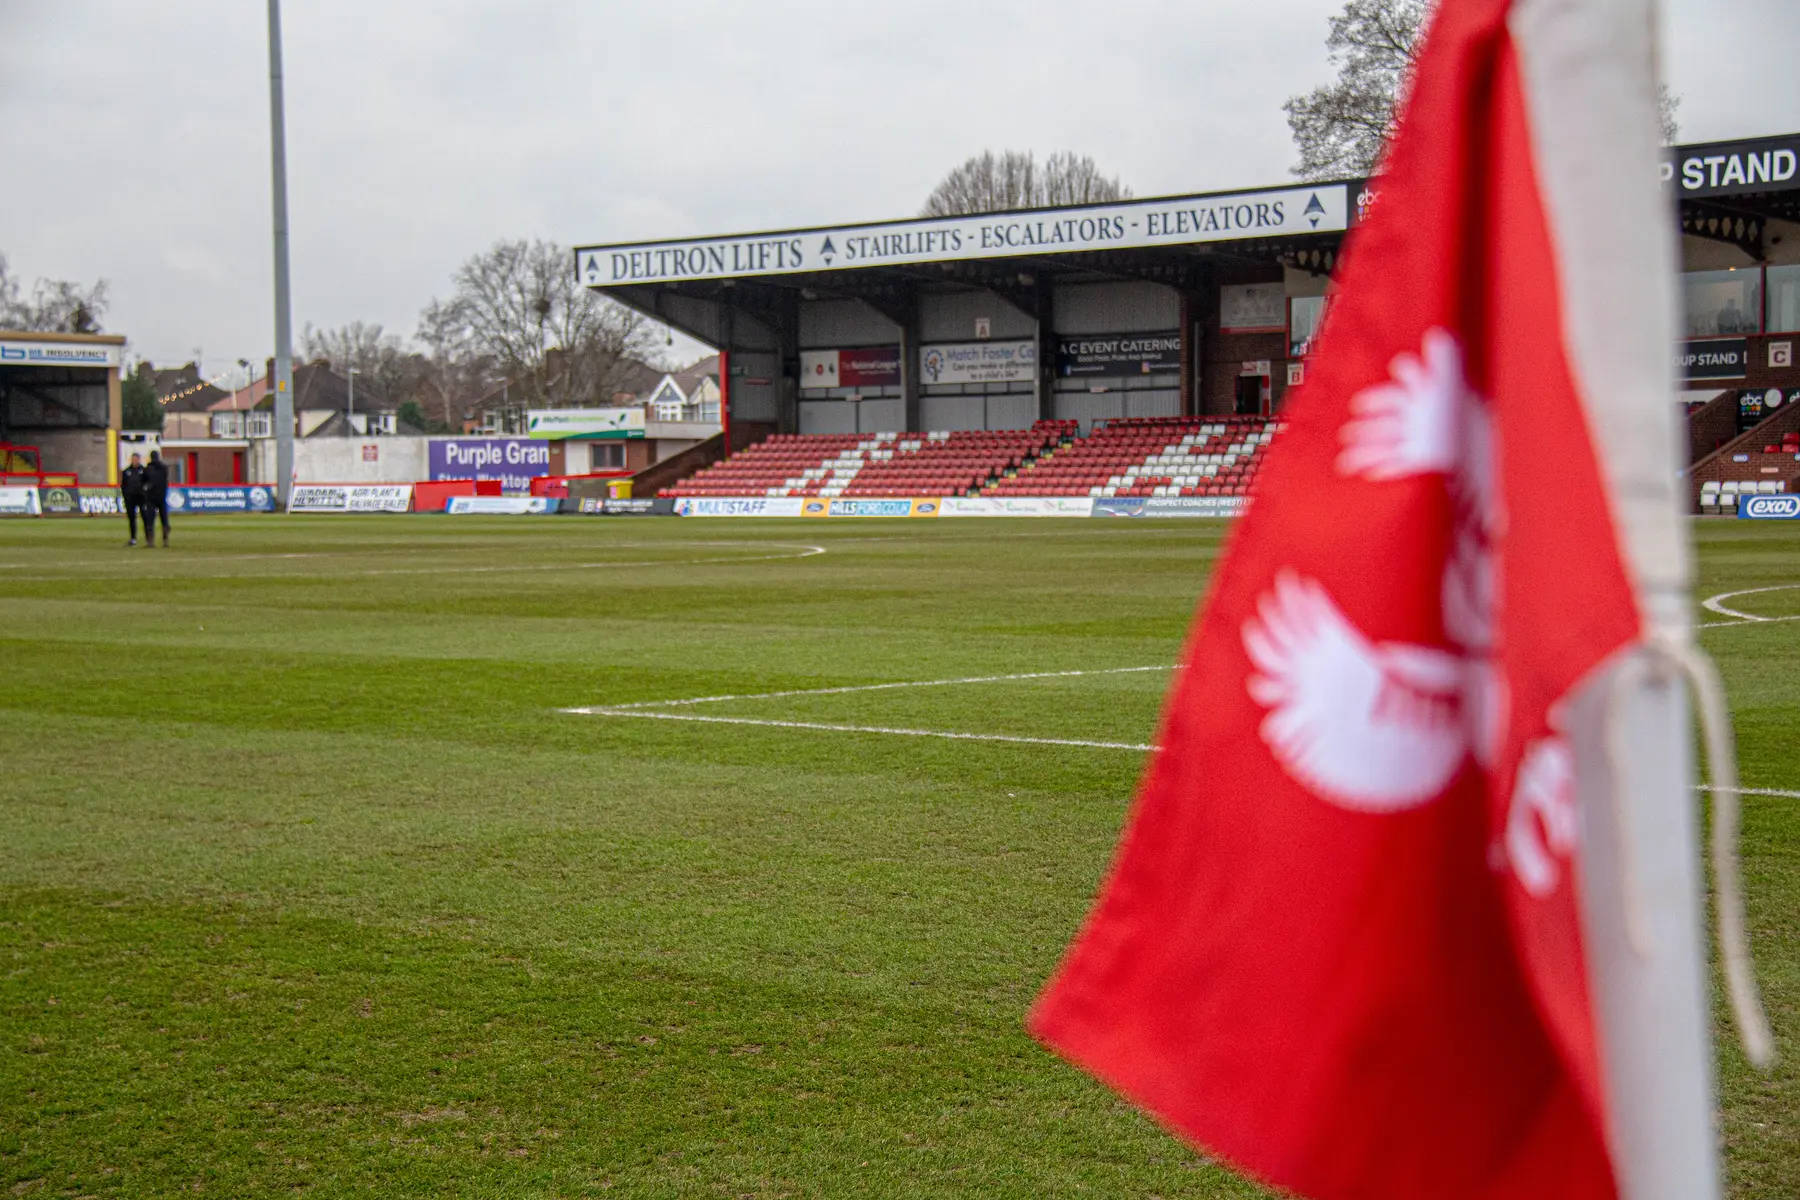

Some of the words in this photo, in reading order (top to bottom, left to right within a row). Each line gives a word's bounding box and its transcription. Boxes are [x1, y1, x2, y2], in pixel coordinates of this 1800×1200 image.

[1681, 149, 1797, 190] STAND
[611, 244, 726, 281] DELTRON
[731, 239, 802, 271] LIFTS
[845, 228, 962, 260] STAIRLIFTS
[979, 215, 1124, 249] ESCALATORS
[1146, 201, 1285, 237] ELEVATORS
[1019, 344, 1035, 359] Ca
[1080, 341, 1119, 354] EVENT
[1120, 338, 1180, 353] CATERING
[1698, 352, 1738, 366] STAND
[1773, 350, 1787, 364] C
[1740, 392, 1762, 406] ebc
[446, 442, 502, 470] Purple
[506, 441, 550, 464] Gran
[188, 489, 227, 499] Partnering
[228, 489, 245, 498] with
[190, 500, 203, 508] our
[204, 499, 246, 509] Community
[697, 501, 767, 514] MULTISTAFF
